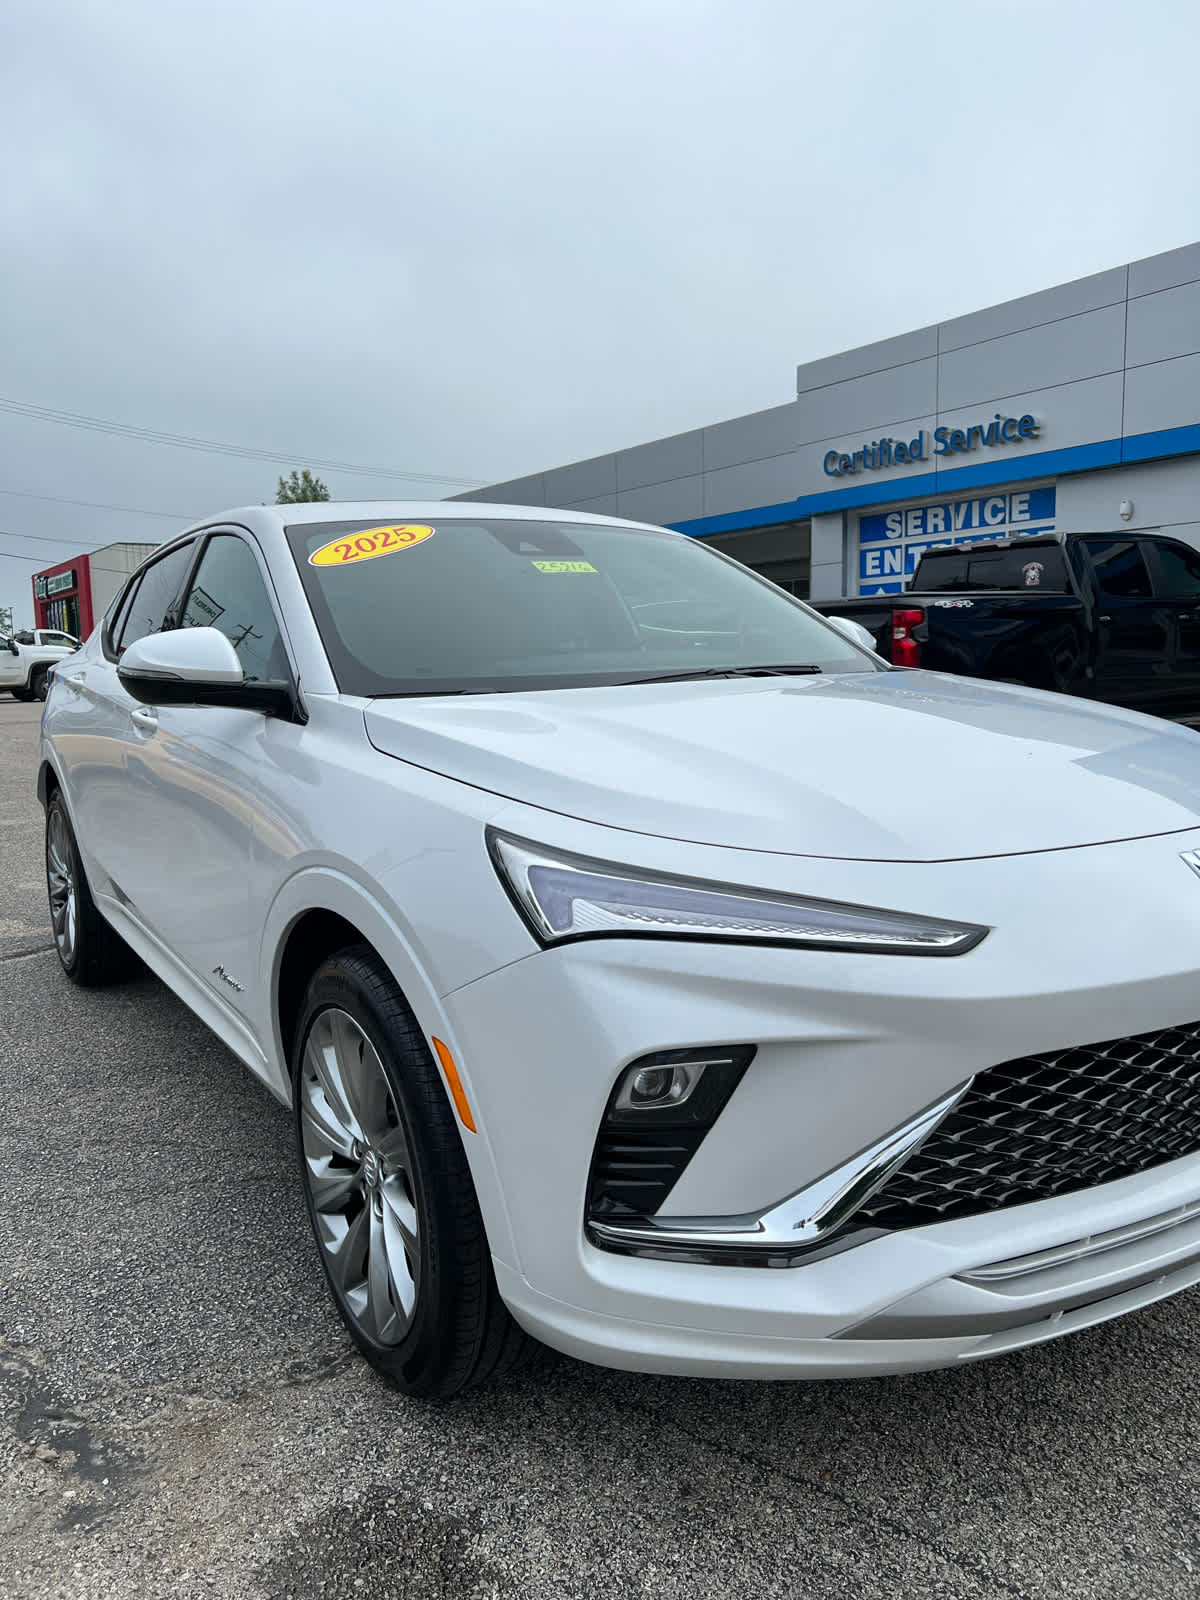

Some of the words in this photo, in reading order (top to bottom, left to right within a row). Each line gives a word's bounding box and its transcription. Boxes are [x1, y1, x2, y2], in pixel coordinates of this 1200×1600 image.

[824, 430, 924, 476] Certified
[934, 413, 1036, 455] Service
[885, 494, 1031, 539] SERVICE
[334, 527, 417, 561] 2025
